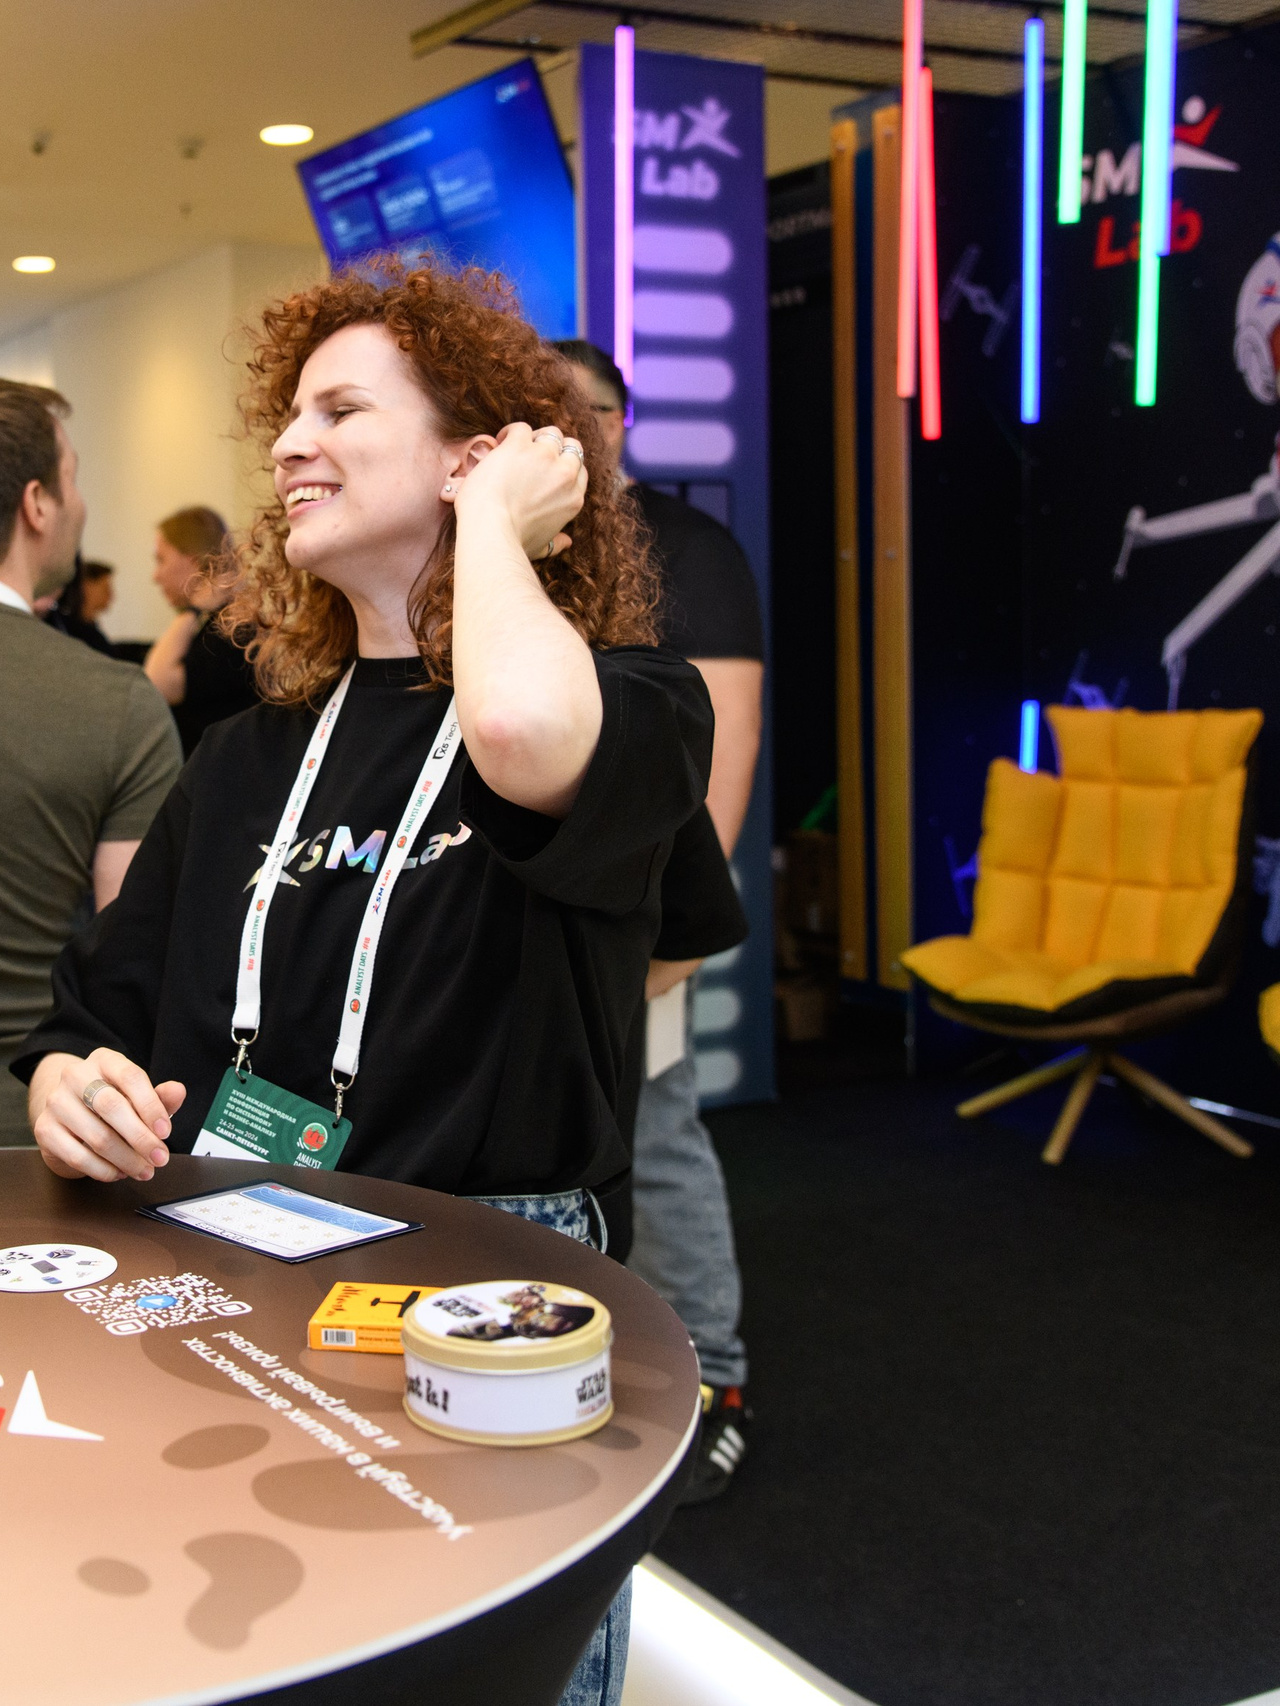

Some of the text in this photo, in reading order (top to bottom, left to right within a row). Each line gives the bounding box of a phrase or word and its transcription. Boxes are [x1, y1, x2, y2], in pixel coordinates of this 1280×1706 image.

[640, 157, 719, 198] Lab
[445, 722, 458, 741] Tech
[404, 807, 420, 832] ANALYST
[417, 794, 427, 807] DAYS
[381, 869, 392, 887] Lab
[251, 915, 261, 942] ANALYST
[354, 937, 371, 996] ANALYST DAYS #18
[228, 1095, 270, 1119] КОНФЕРЕНЦИЯ
[234, 1105, 272, 1128] СИСТЕМНОМУ
[245, 1096, 297, 1124] МЕЖДУНАРОДНАЯ
[219, 1118, 236, 1130] 24-25
[244, 1130, 258, 1142] 2024
[228, 1111, 277, 1138] БИЗНЕС-АНАЛИЗУ
[215, 1126, 270, 1156] САНКТ-ПЕТЕРБУРГ
[296, 1152, 322, 1169] ANALYST
[212, 1330, 401, 1450] и выигрывай призы!
[182, 1336, 474, 1541] Участвуй в наших активностях
